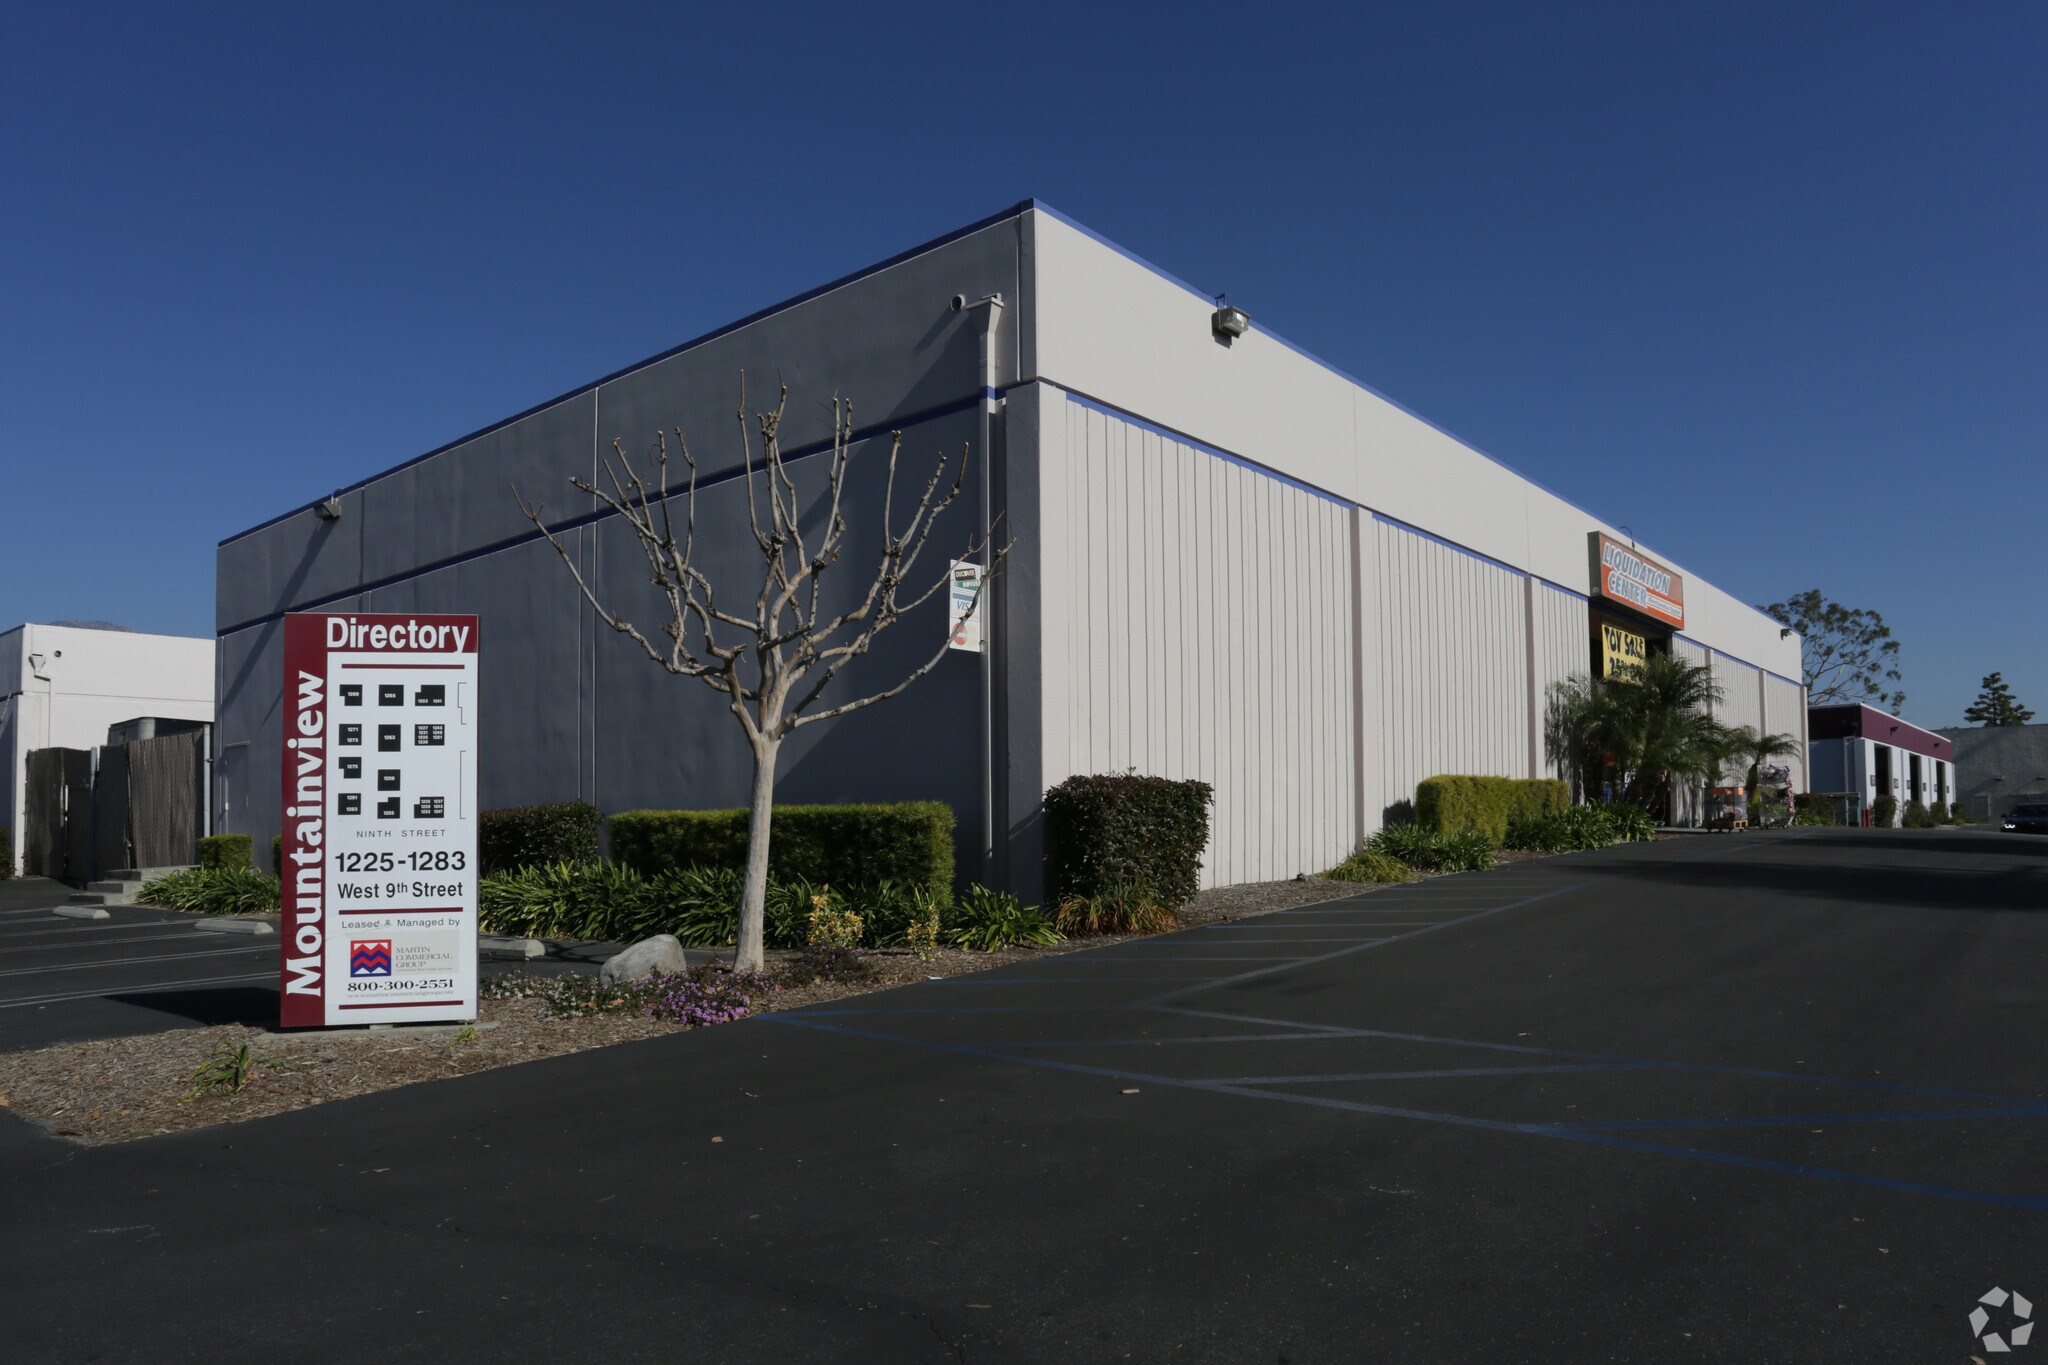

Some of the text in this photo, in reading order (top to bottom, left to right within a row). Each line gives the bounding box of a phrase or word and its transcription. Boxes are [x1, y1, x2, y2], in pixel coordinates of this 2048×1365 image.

[1603, 542, 1671, 595] LIQUIDATION
[1608, 571, 1648, 608] CENTER
[326, 617, 469, 653] Directory
[1604, 626, 1644, 660] TOY SALE
[286, 670, 324, 997] Mountainview
[356, 829, 446, 838] NINTH STREET
[335, 851, 466, 872] 1225-1283
[338, 881, 463, 899] West 9th Street
[342, 920, 380, 929] Leased
[397, 918, 444, 928] Managed
[448, 917, 461, 926] by
[396, 946, 431, 954] MARTIN
[396, 953, 453, 961] COMMERCIAL
[396, 961, 427, 969] GROUP
[347, 978, 454, 992] 800-300-2551
